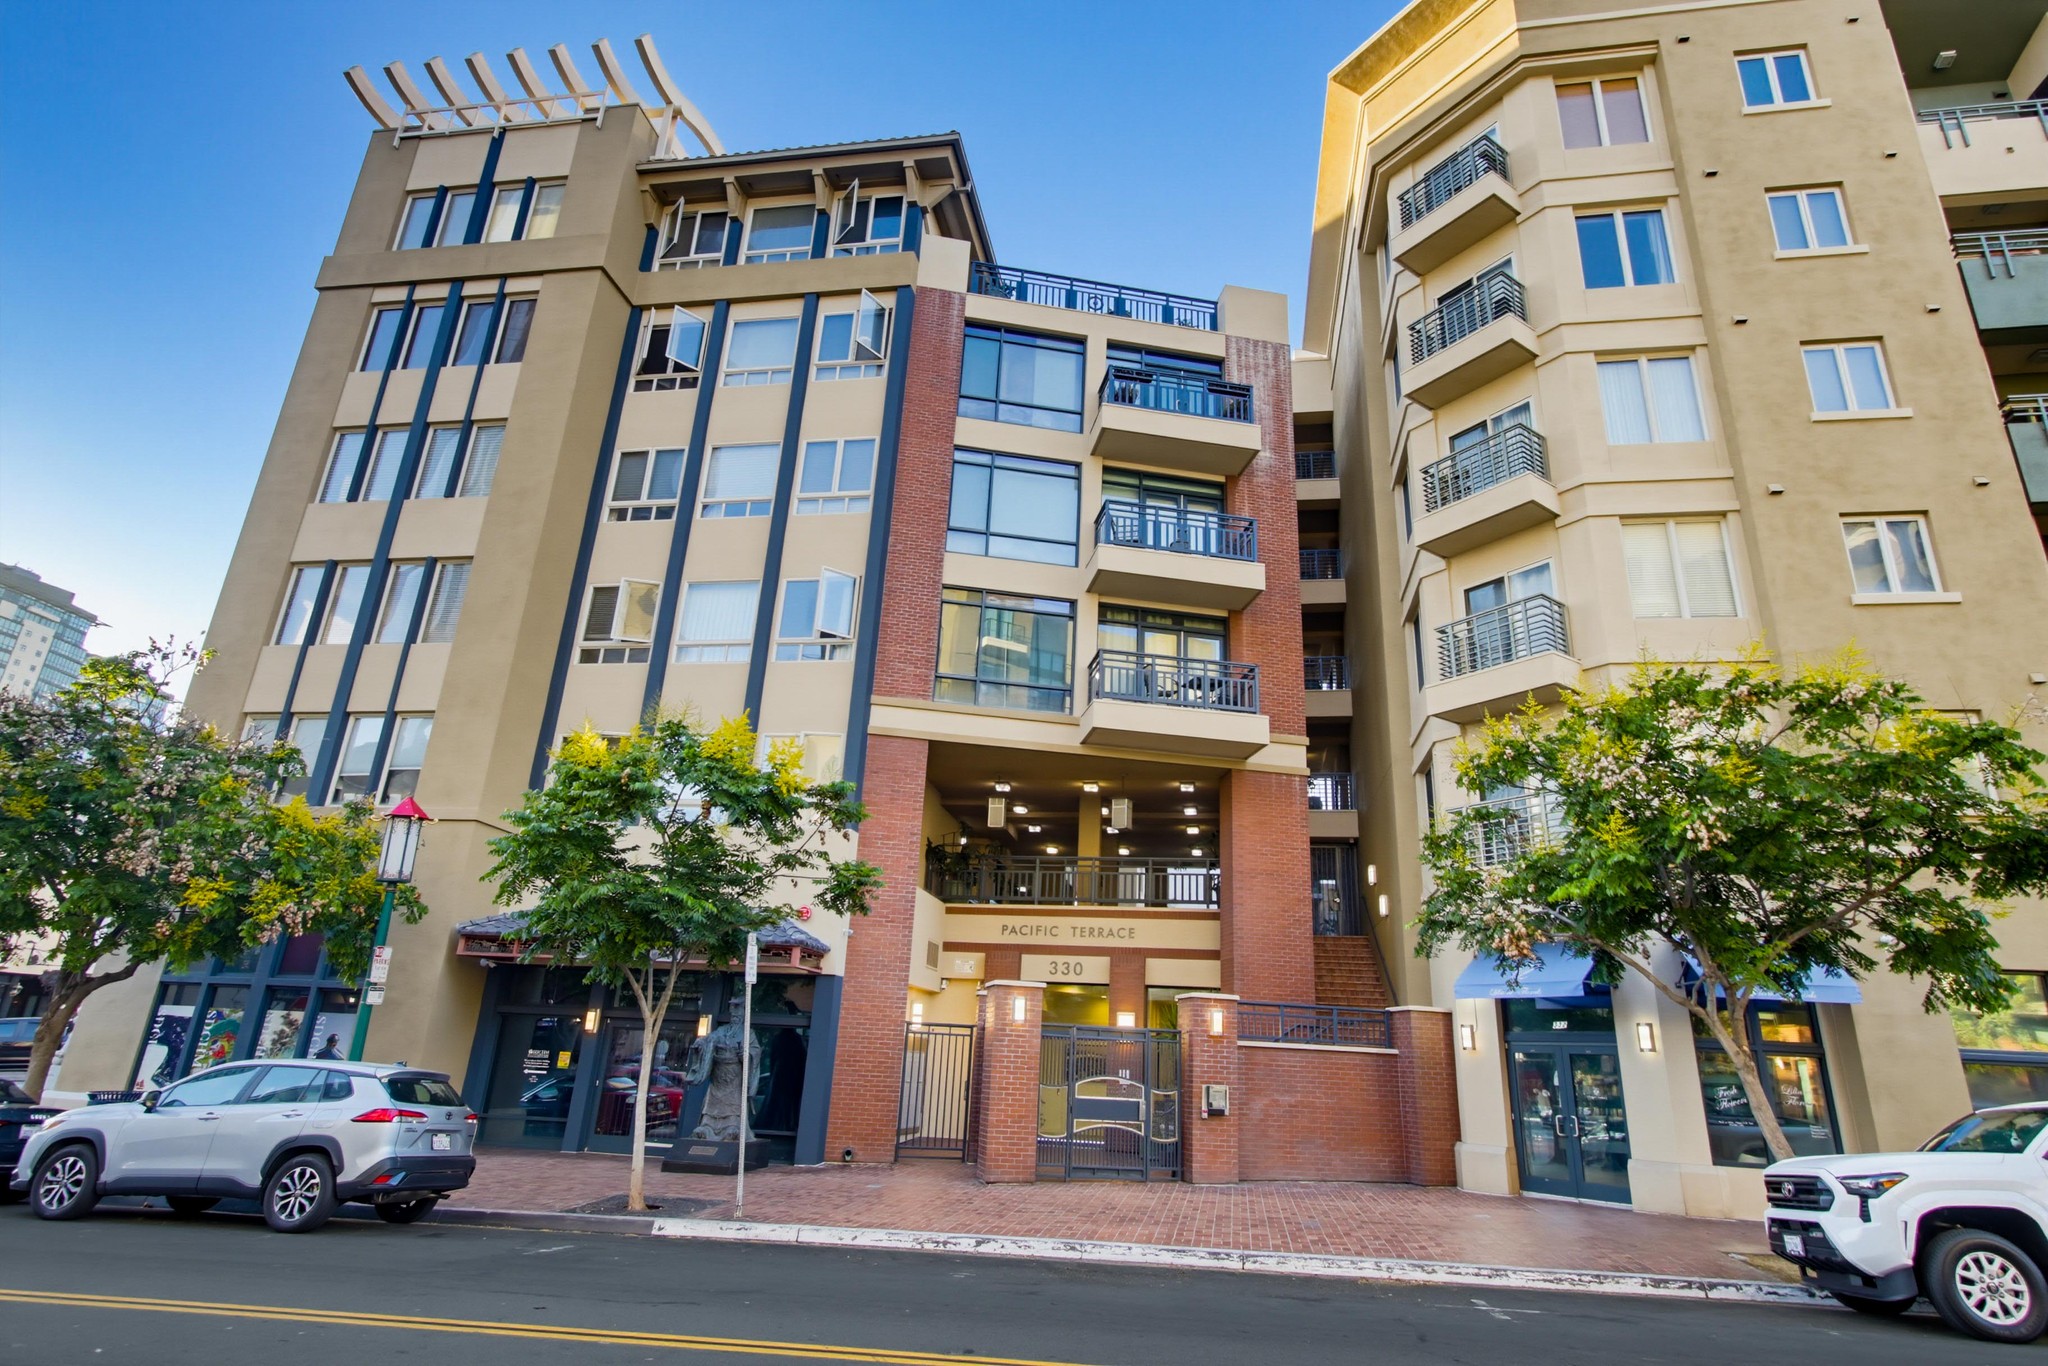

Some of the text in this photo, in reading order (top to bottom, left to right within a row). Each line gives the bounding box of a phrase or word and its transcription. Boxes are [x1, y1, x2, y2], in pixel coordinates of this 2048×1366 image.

[1001, 924, 1135, 939] PACIFIC TERRACE
[1049, 961, 1083, 976] 330
